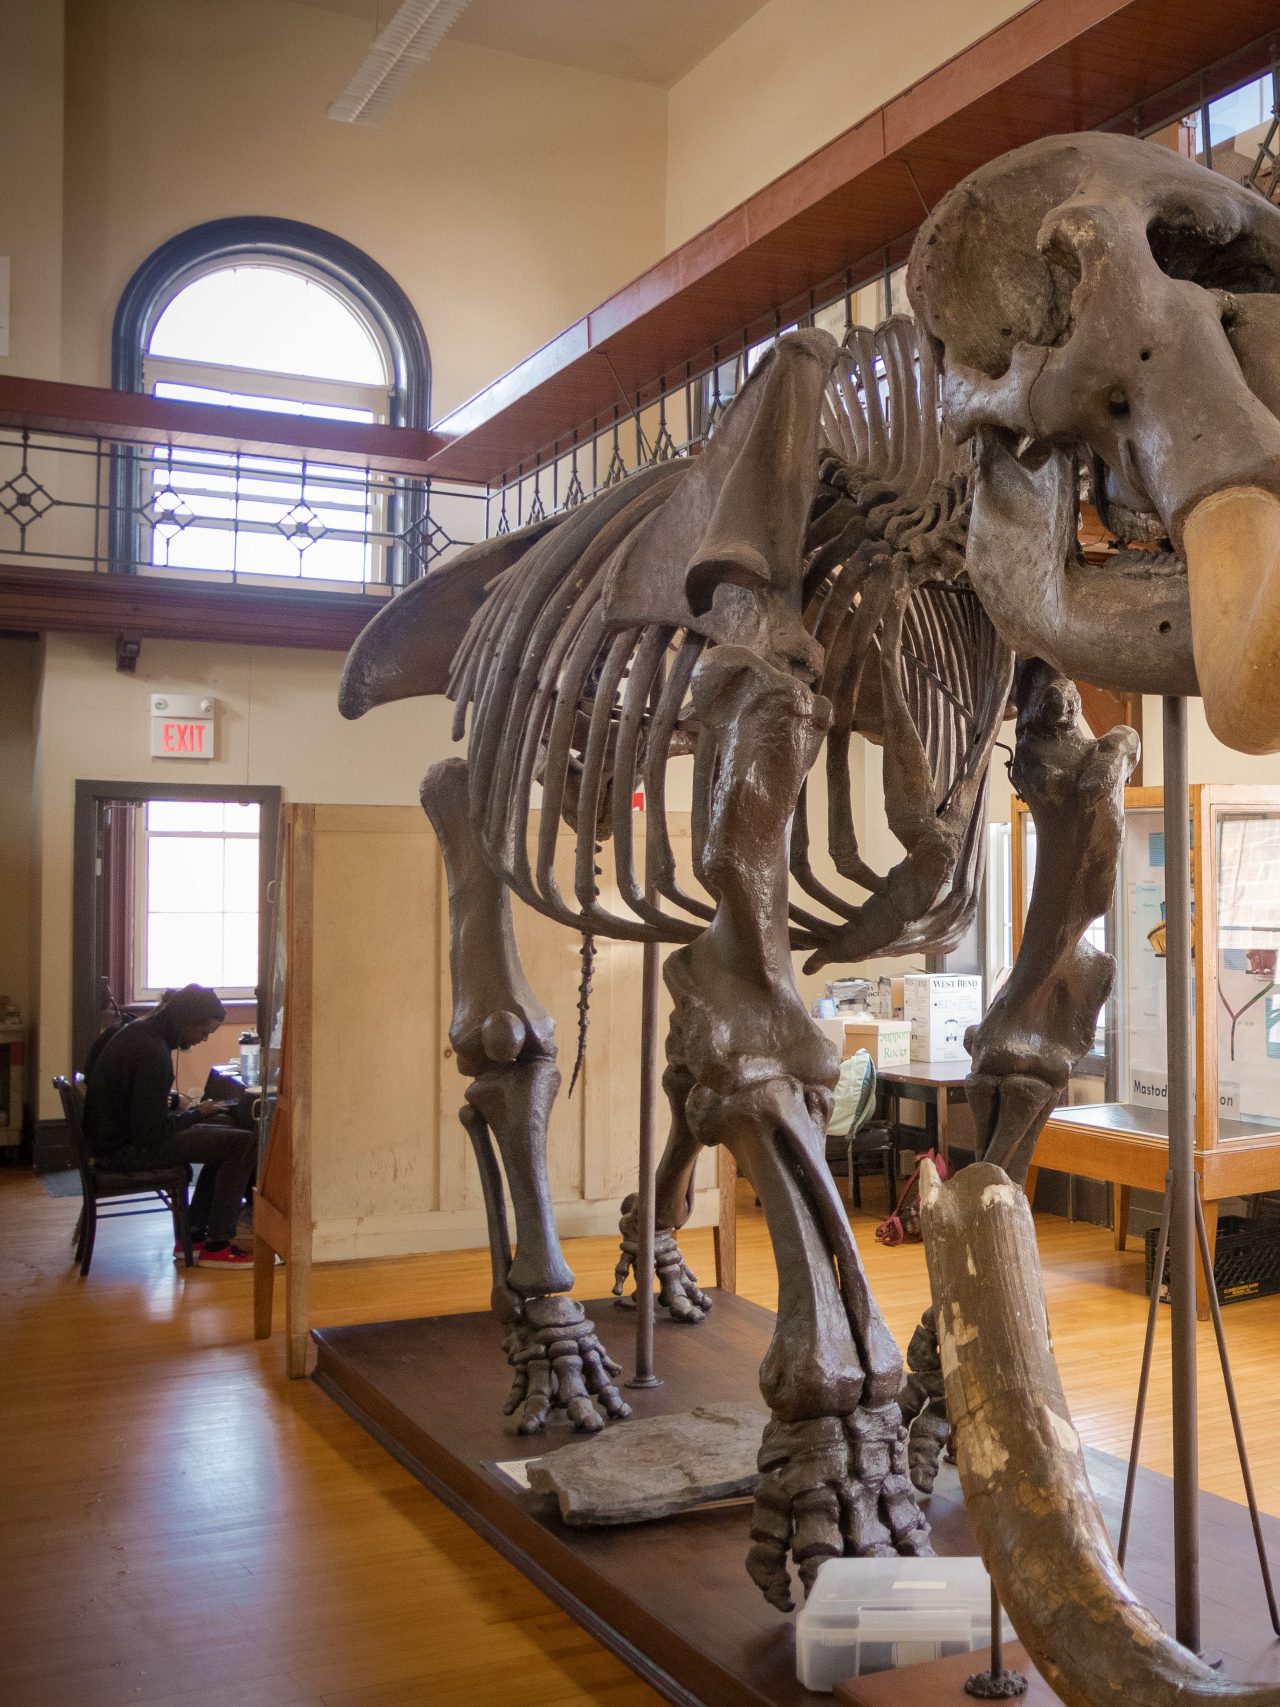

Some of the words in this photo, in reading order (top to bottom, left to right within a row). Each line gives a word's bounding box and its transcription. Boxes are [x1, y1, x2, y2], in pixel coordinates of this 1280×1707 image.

[162, 723, 205, 753] EXIT
[933, 980, 954, 988] WEST
[957, 979, 978, 988] BEND
[1133, 1079, 1168, 1098] Mastod
